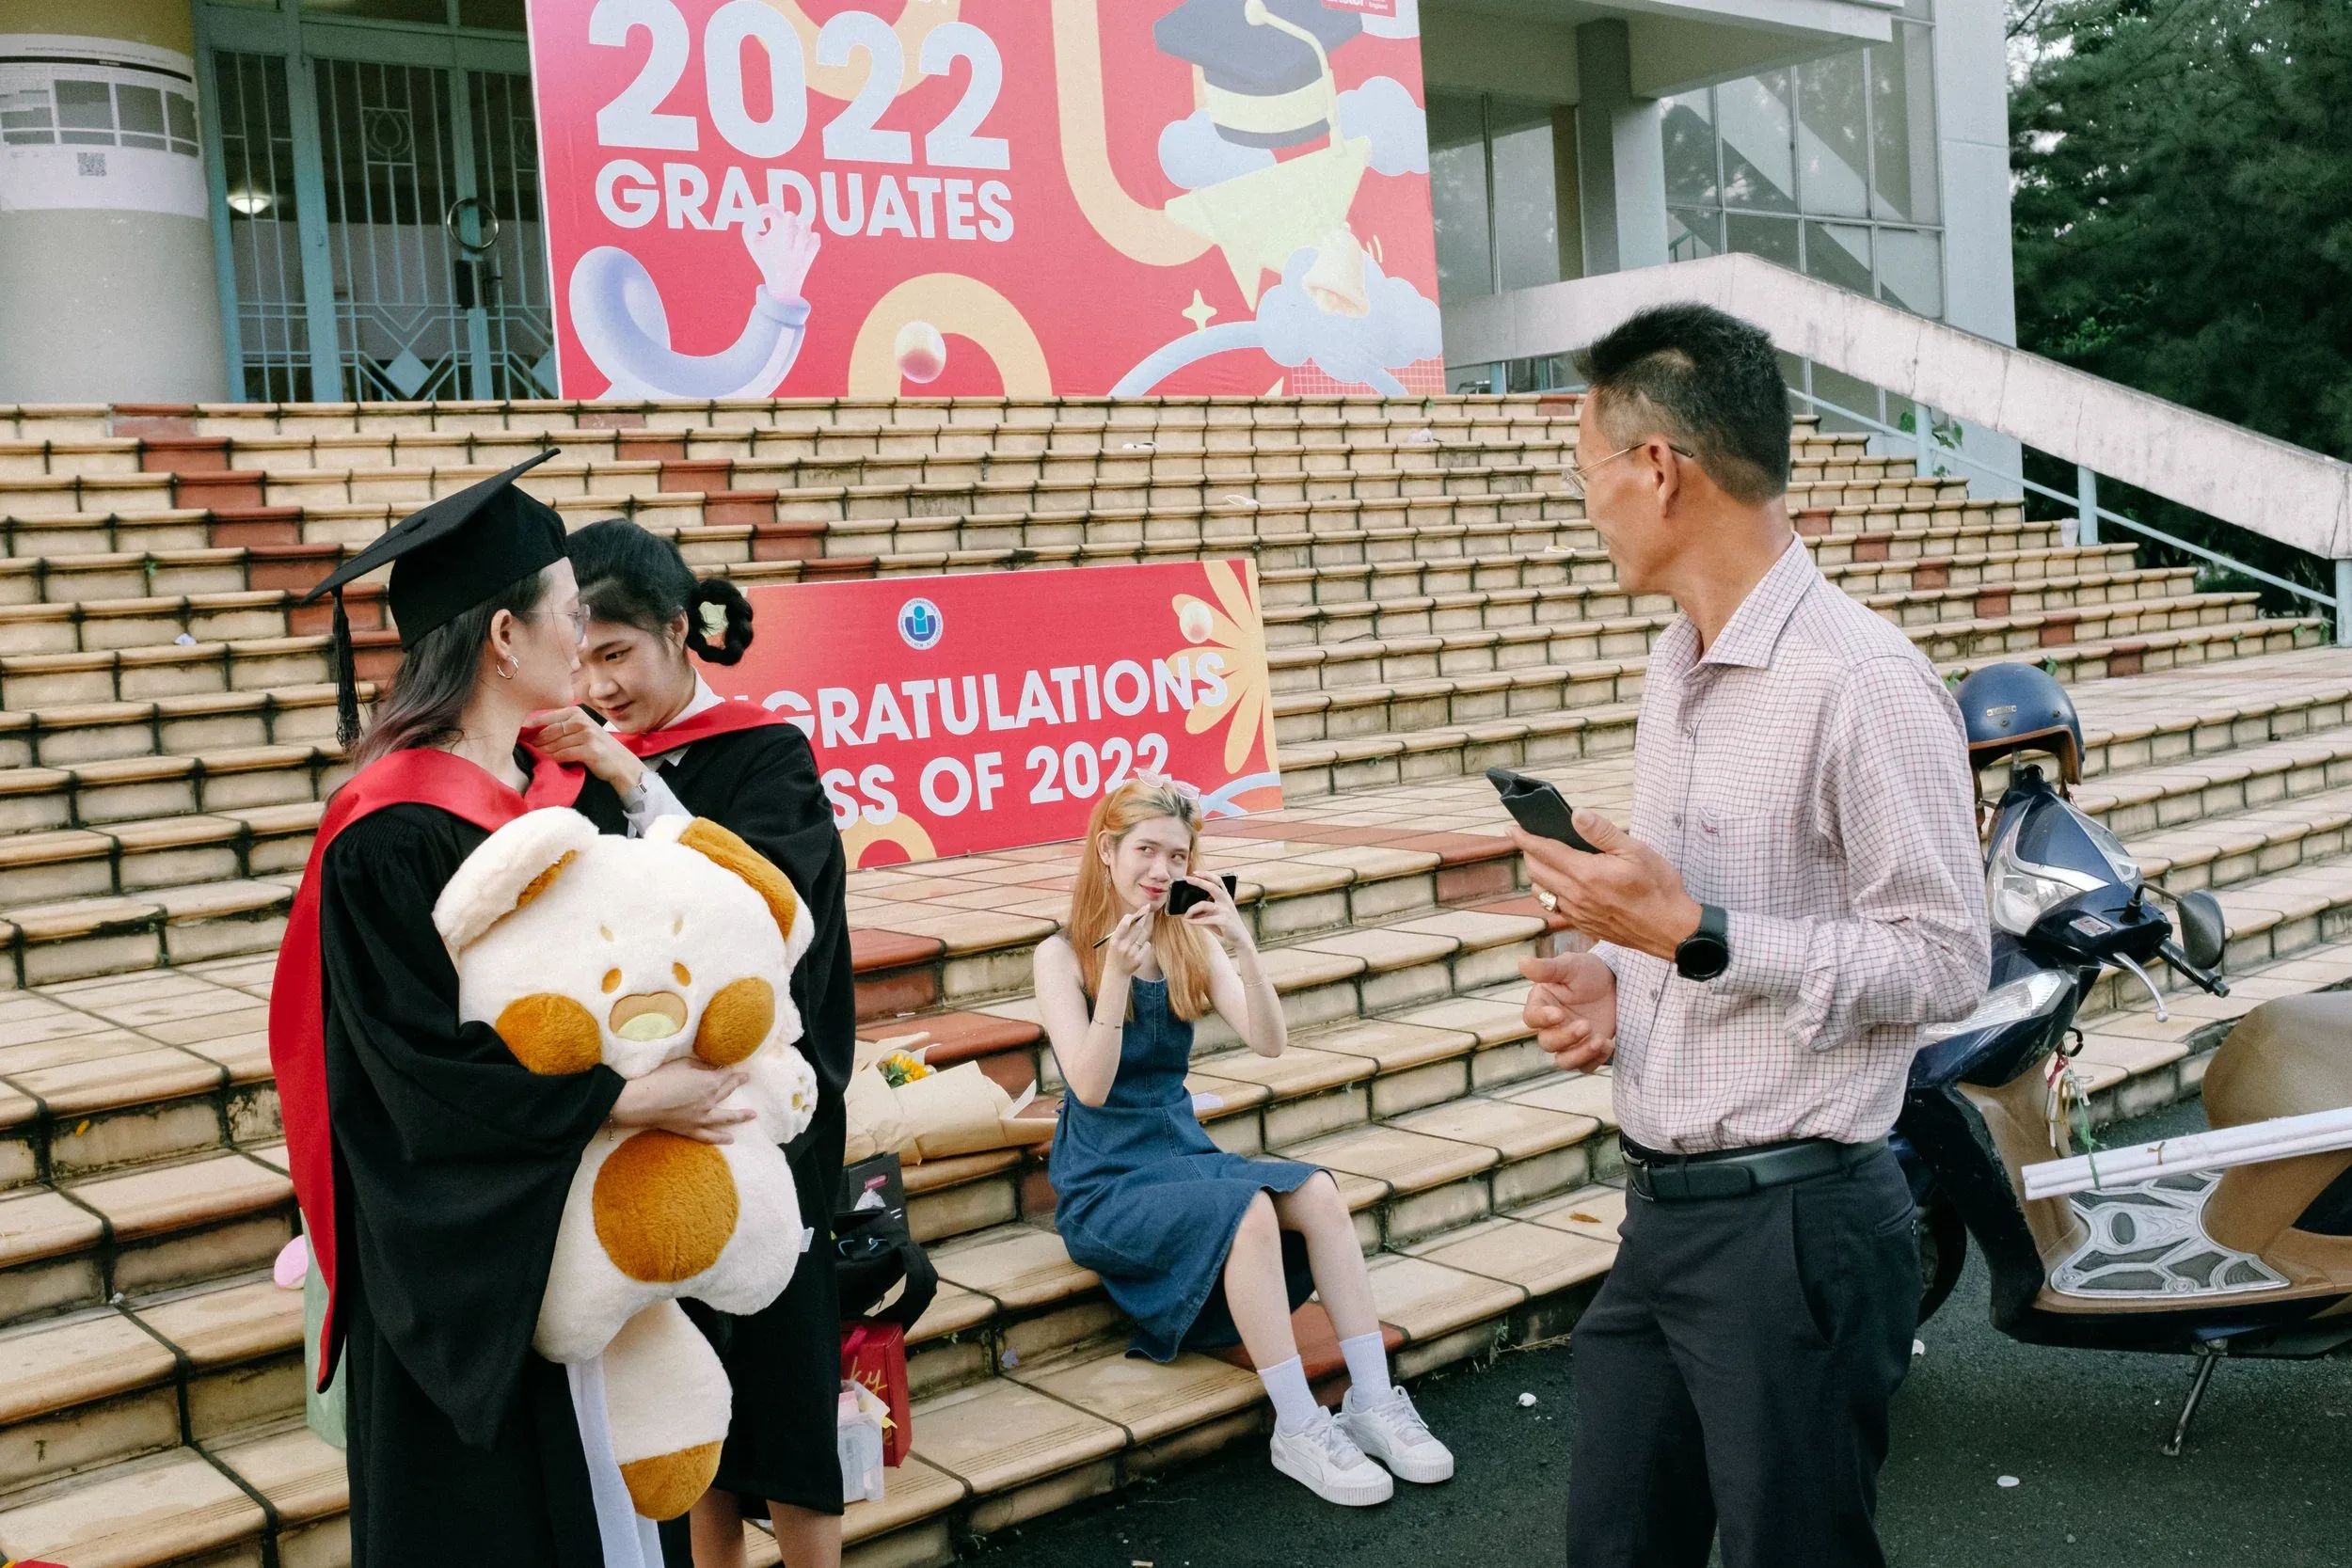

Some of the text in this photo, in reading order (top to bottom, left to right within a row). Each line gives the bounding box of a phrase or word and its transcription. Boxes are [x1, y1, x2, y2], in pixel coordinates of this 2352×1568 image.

[589, 0, 1010, 170] 2022
[595, 159, 1015, 243] GRADUATES
[734, 652, 1229, 749] GRATULATIONS
[919, 752, 1005, 816] OF
[1025, 732, 1172, 804] 2022
